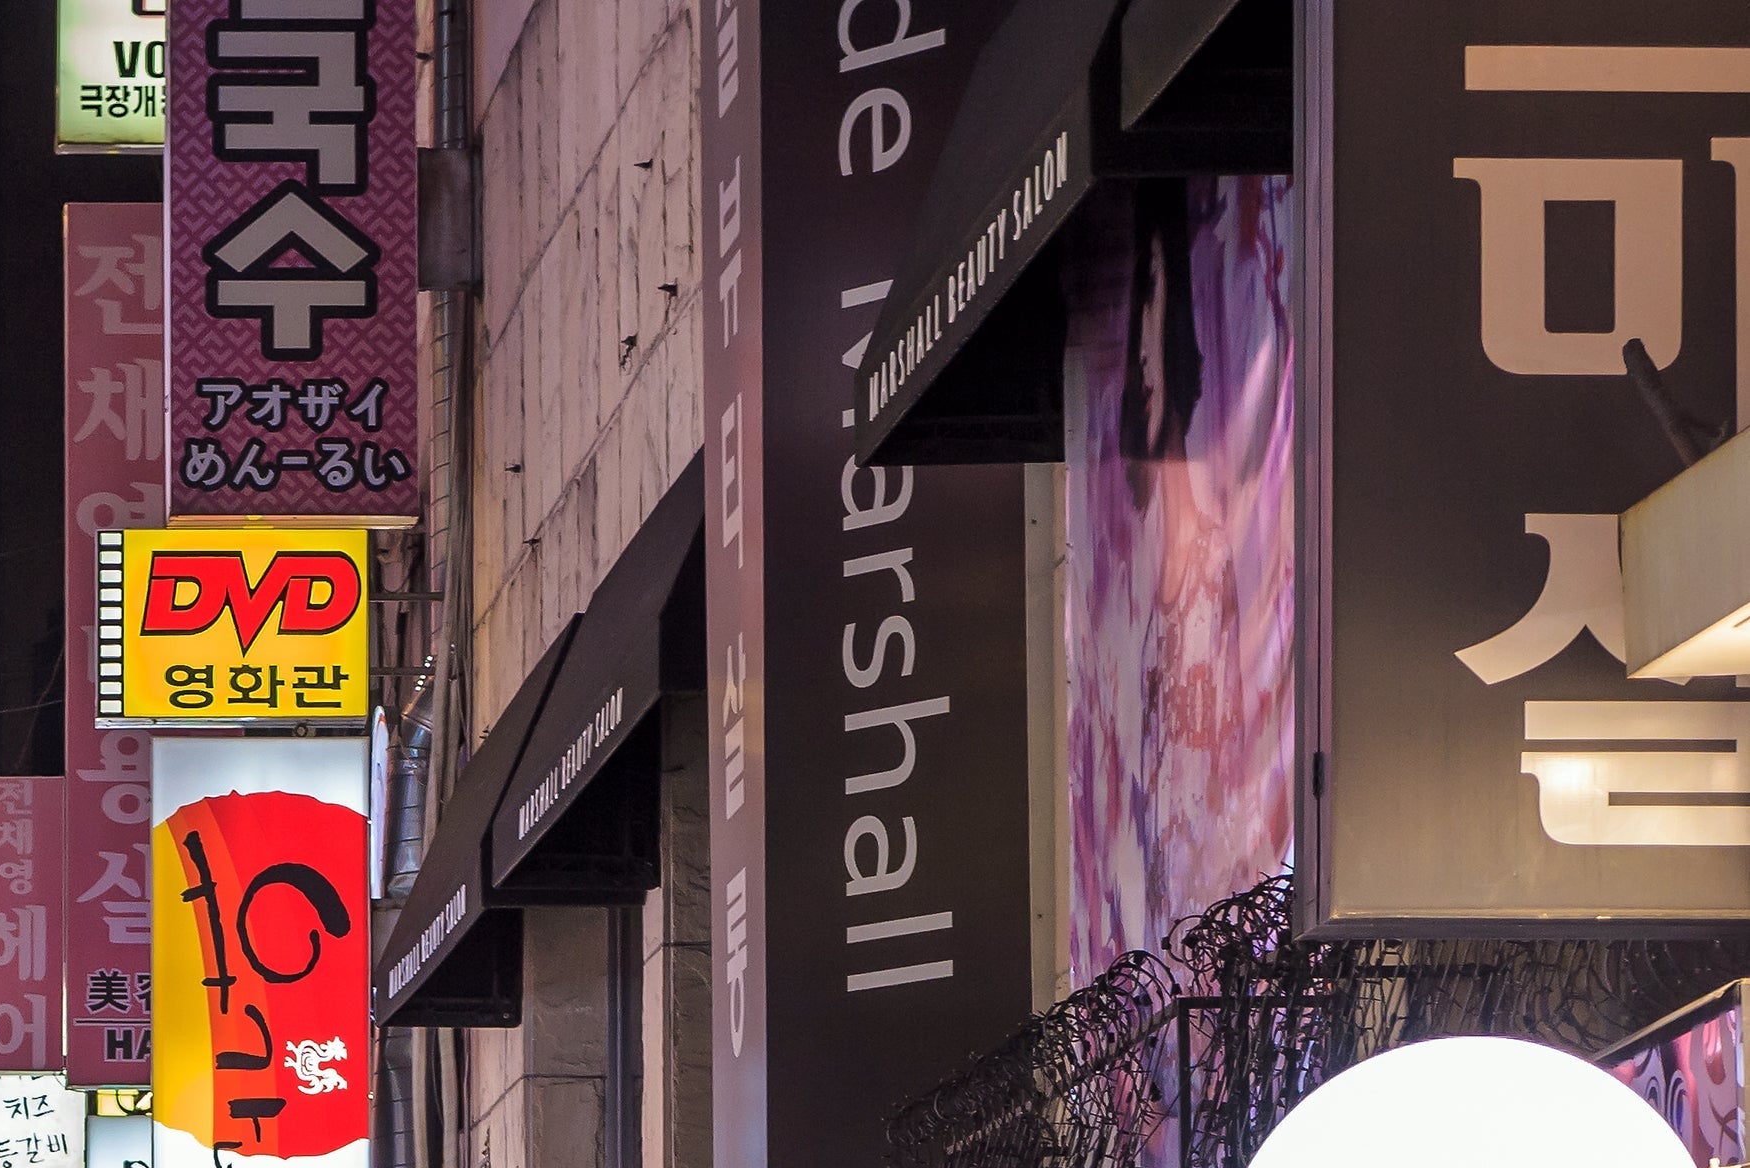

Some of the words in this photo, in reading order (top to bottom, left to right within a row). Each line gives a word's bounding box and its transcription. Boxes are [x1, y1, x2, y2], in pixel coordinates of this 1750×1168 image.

[868, 294, 943, 422] MARSHALL
[948, 208, 1007, 324] BEAUTY
[1012, 131, 1068, 241] SALON
[200, 382, 387, 428] アオザイ
[140, 550, 362, 656] DVD
[163, 663, 351, 710] 영화관
[2, 1095, 55, 1120] 치즈
